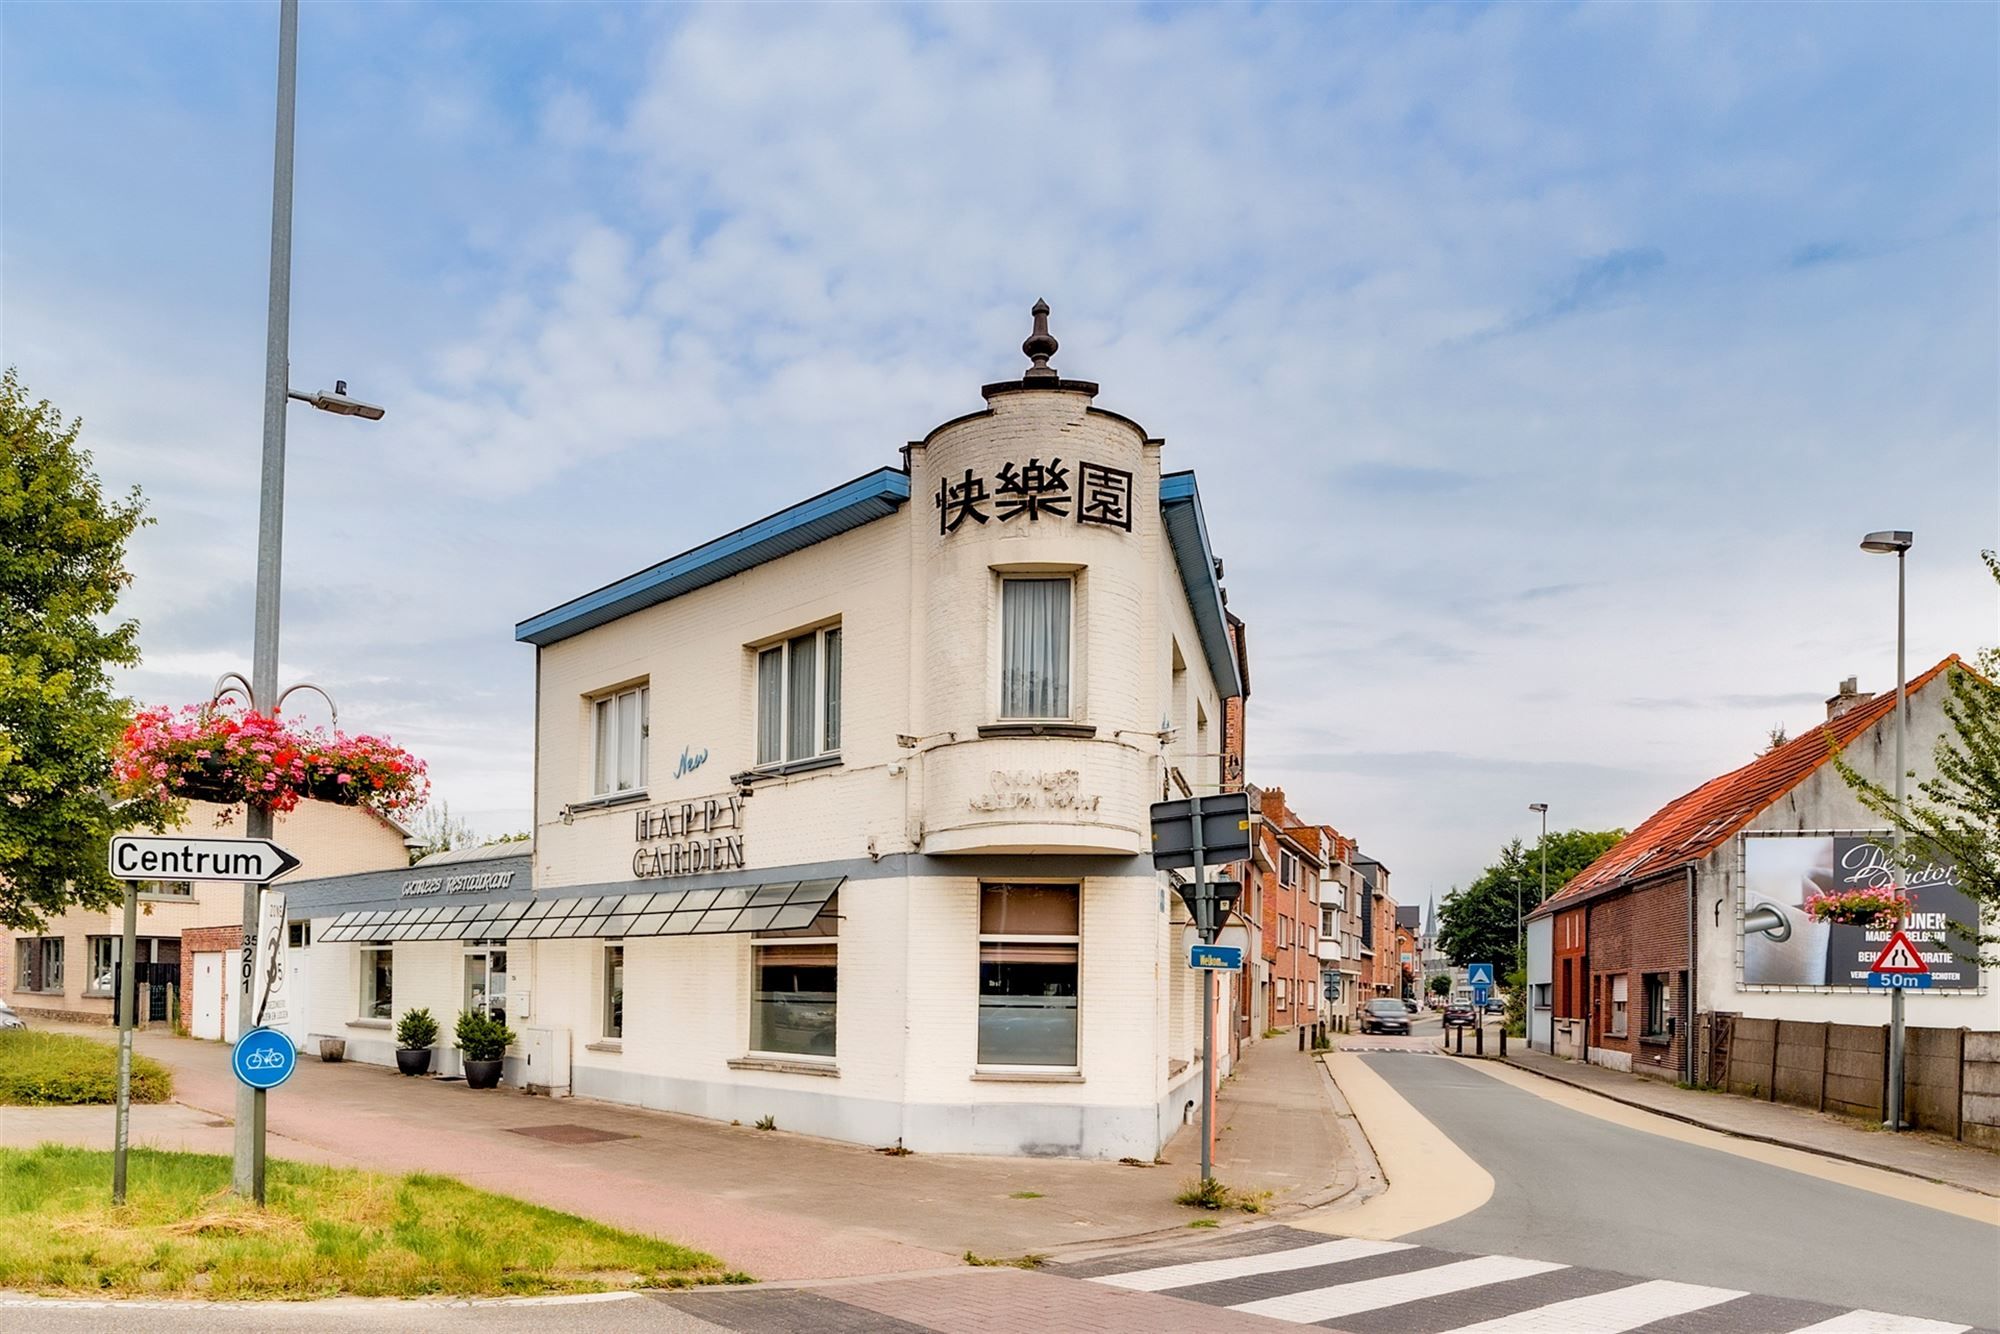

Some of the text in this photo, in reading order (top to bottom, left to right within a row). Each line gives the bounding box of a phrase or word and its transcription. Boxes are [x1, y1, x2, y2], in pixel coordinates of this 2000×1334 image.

[935, 458, 1132, 535] 快樂園
[673, 744, 708, 779] New
[635, 796, 742, 842] HAPPY
[118, 843, 262, 875] Centrum
[632, 835, 744, 878] GARDEN
[1865, 931, 1892, 942] MADE
[1881, 974, 1918, 987] 50m
